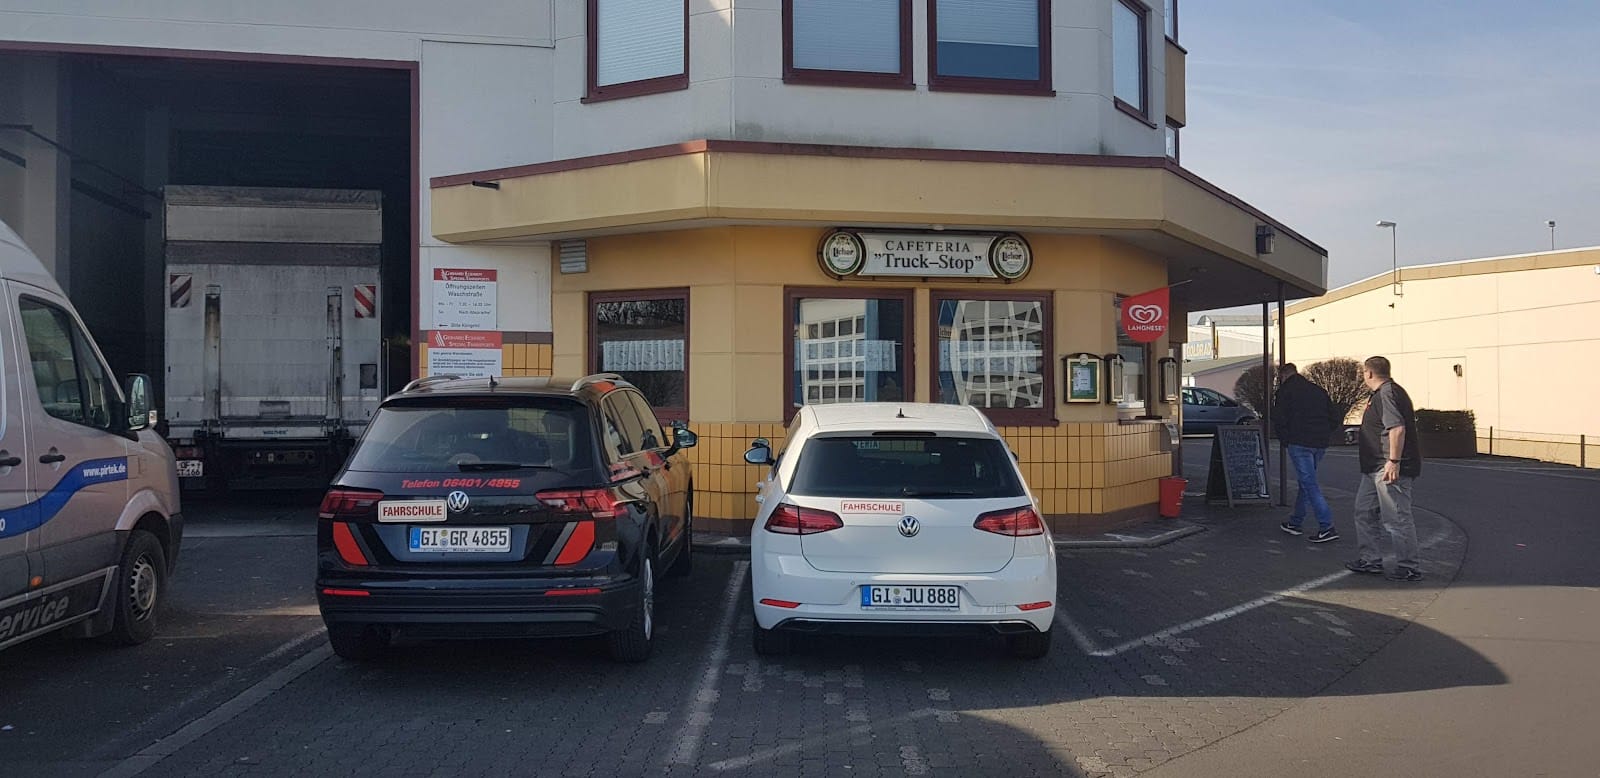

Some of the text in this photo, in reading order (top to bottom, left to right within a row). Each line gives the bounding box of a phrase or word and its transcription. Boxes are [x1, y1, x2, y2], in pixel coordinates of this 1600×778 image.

[885, 240, 970, 253] CAFETERIA
[446, 282, 486, 291] Öffnungszeiten
[83, 463, 126, 478] www.pirtek.de
[401, 478, 521, 489] Telefon 06401/4855
[383, 504, 443, 517] FAHRSCHULE
[843, 502, 902, 512] FAHRSCHULE
[421, 531, 438, 546] GI
[450, 531, 468, 546] GR
[472, 530, 507, 546] 4855
[872, 588, 891, 603] GI
[903, 588, 924, 604] JU
[927, 588, 957, 604] 888
